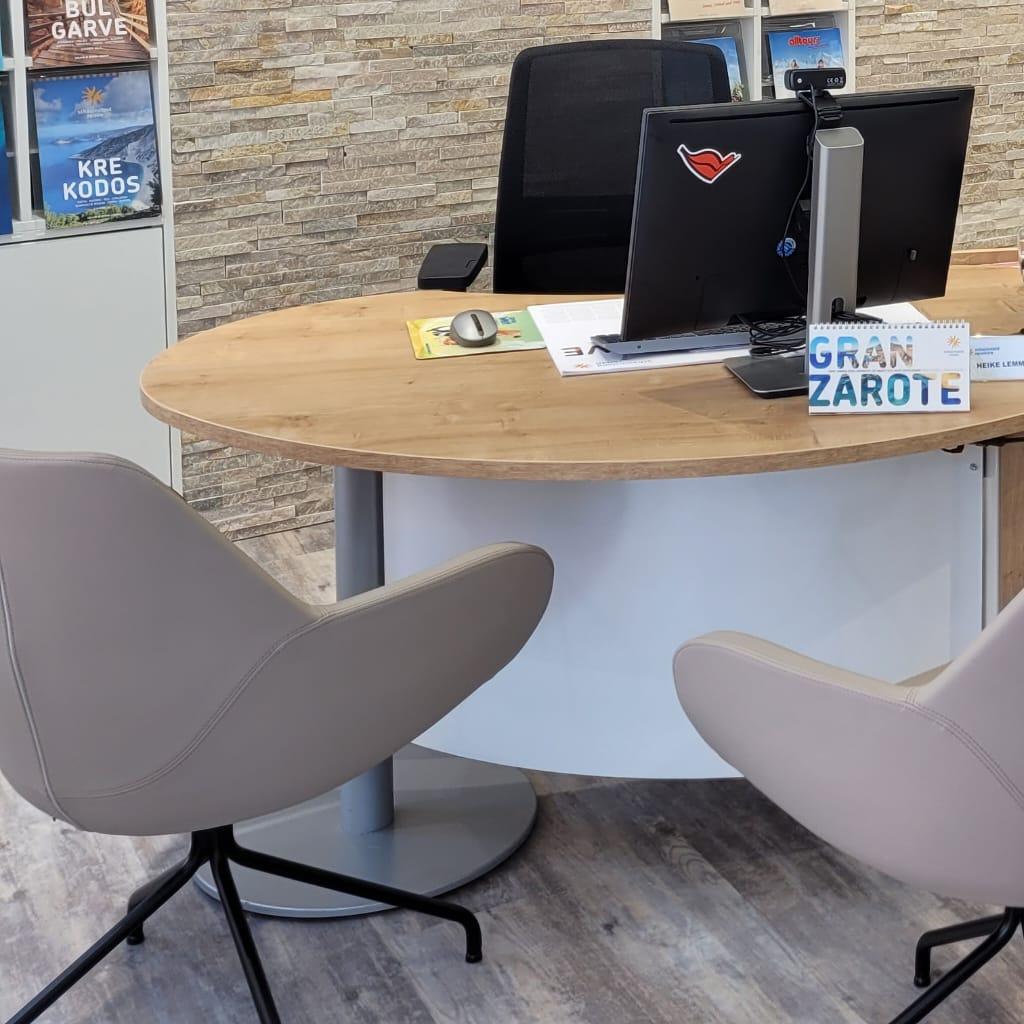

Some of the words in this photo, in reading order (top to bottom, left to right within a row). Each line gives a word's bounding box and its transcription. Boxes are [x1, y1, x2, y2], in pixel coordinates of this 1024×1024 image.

[65, 0, 111, 18] BUL
[52, 17, 128, 39] GARVE
[78, 157, 122, 178] KRE
[63, 176, 140, 200] KODOS
[809, 335, 913, 369] GRAN
[976, 360, 1000, 369] HEIKE
[1002, 360, 1024, 368] LEMM
[808, 373, 961, 406] ZAROTE
